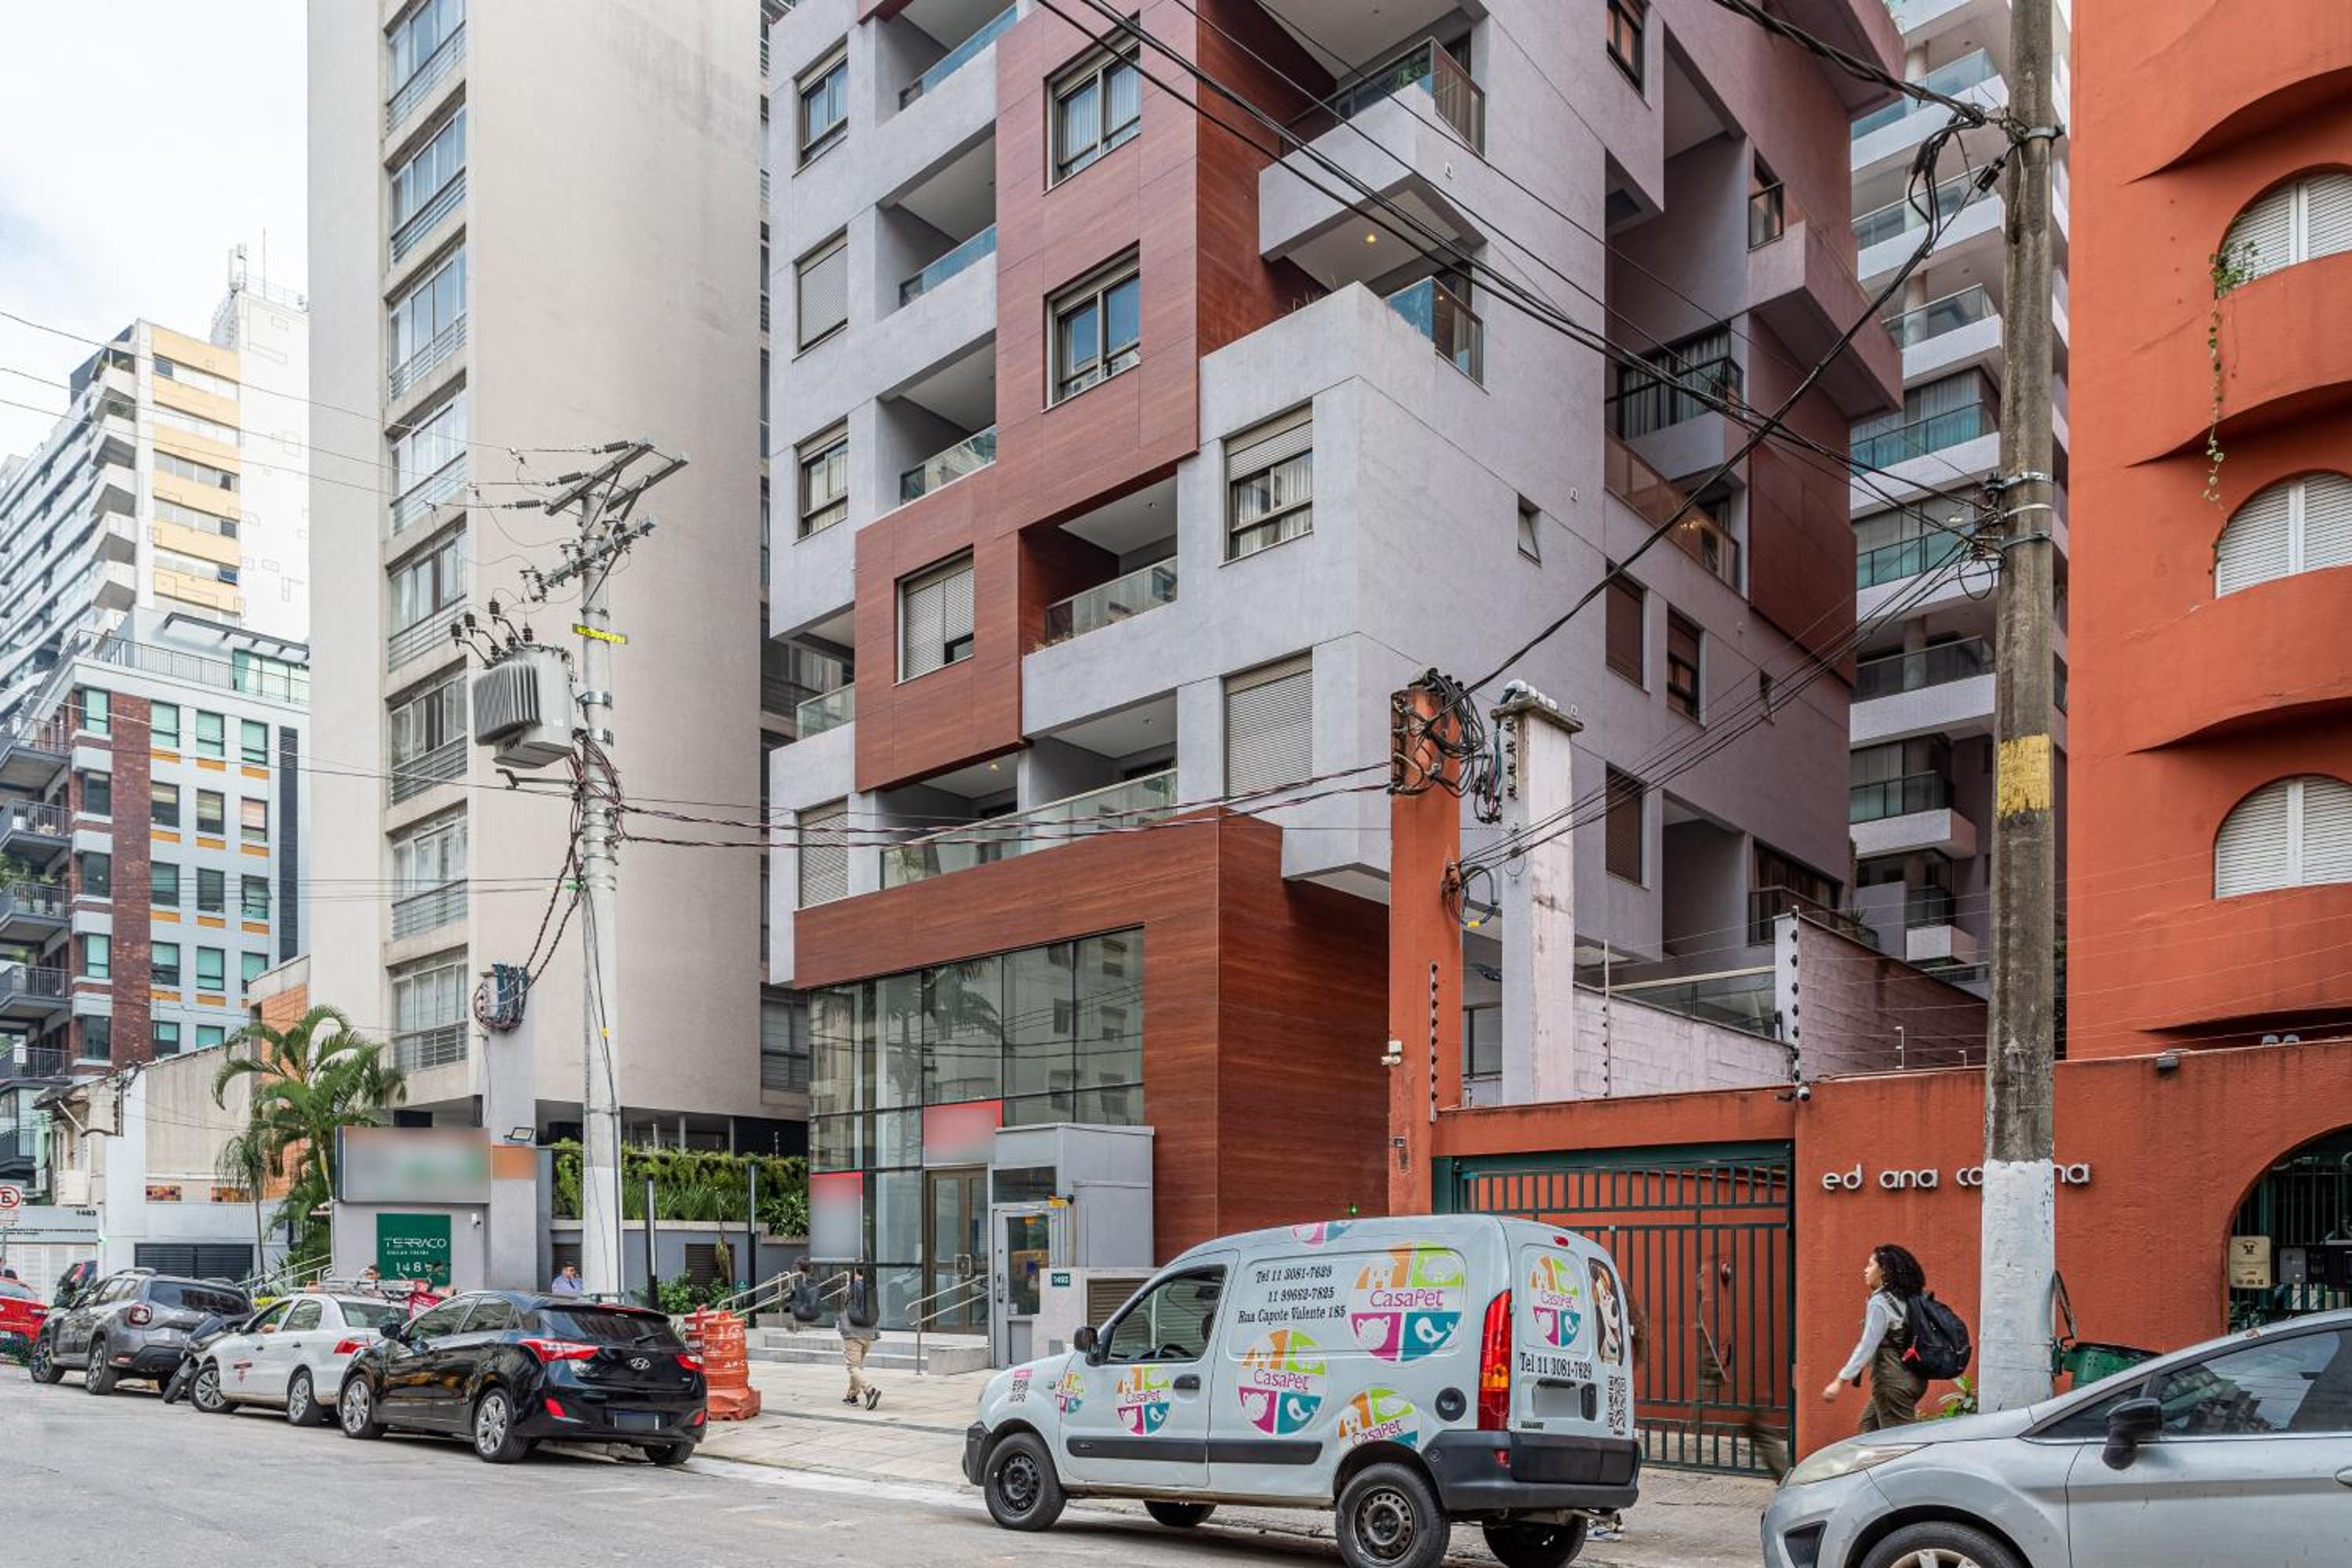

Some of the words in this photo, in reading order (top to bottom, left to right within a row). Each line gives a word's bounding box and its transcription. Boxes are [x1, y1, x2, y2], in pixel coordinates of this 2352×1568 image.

[1822, 1163, 1863, 1190] ed
[1879, 1168, 1938, 1189] ana
[1256, 1269, 1270, 1283] Tel
[1272, 1269, 1282, 1281] 11
[1268, 1290, 1278, 1302] 11
[1370, 1288, 1444, 1307] CasaPet
[1238, 1310, 1254, 1324] Rua
[1258, 1308, 1289, 1326] Capote
[1291, 1306, 1326, 1320] Valente
[1519, 1352, 1534, 1373] Tel
[1538, 1356, 1548, 1374] 11
[1254, 1368, 1311, 1390] CasaPet
